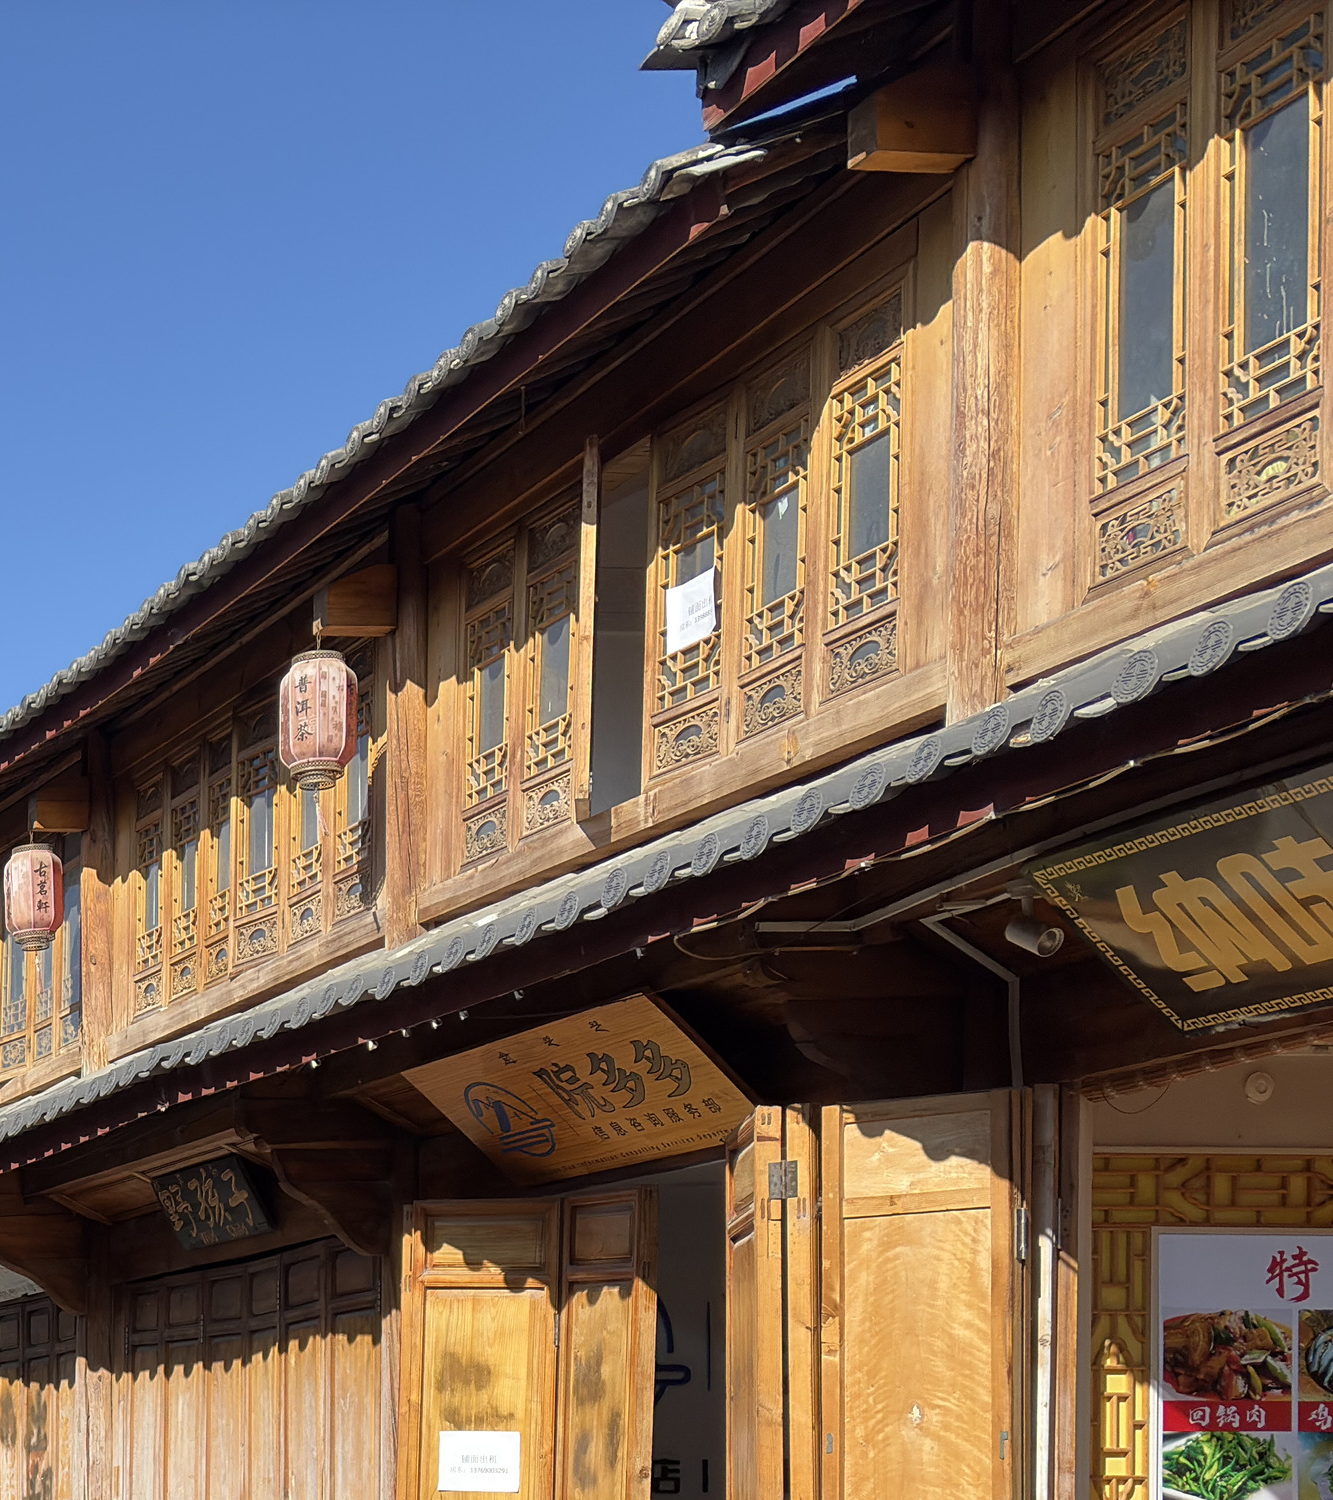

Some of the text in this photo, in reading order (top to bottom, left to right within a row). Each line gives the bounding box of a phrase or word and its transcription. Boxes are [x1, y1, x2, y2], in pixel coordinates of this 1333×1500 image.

[294, 674, 313, 742] 普洱茶
[532, 1039, 692, 1120] 院多多
[591, 1097, 722, 1142] 信息咨询服务部
[1265, 1246, 1320, 1303] 特
[1189, 1404, 1266, 1429] 回锅肉
